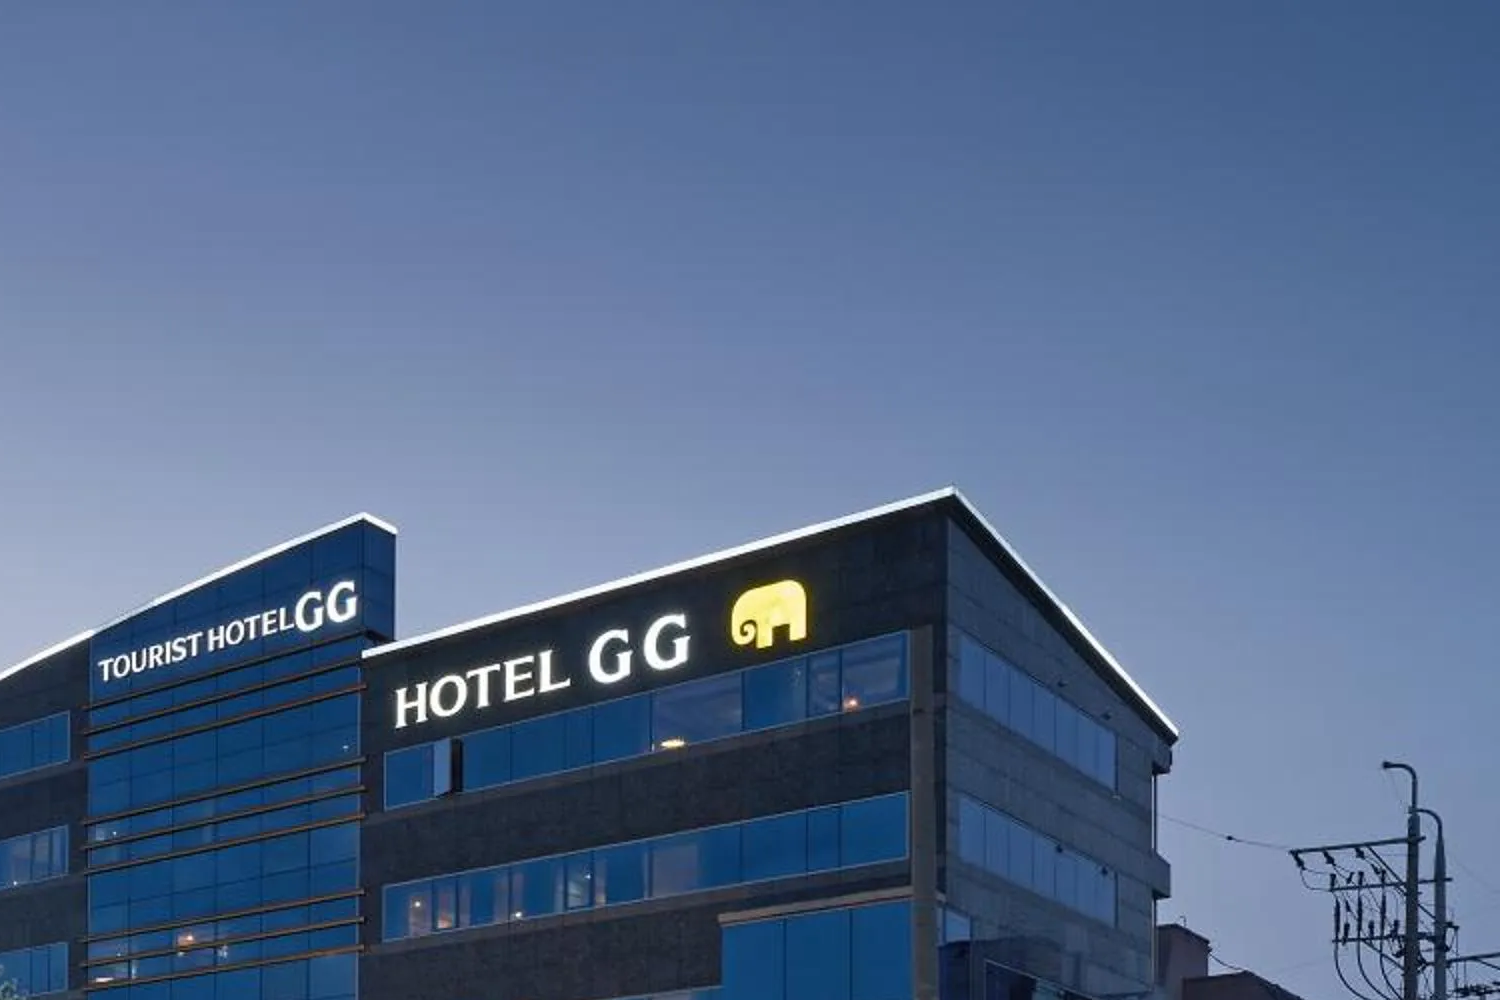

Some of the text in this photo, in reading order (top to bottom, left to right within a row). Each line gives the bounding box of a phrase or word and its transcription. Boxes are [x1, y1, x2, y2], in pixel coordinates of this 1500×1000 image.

[98, 580, 358, 682] TOURIST HOTEL GG
[395, 613, 691, 730] HOTEL GG
